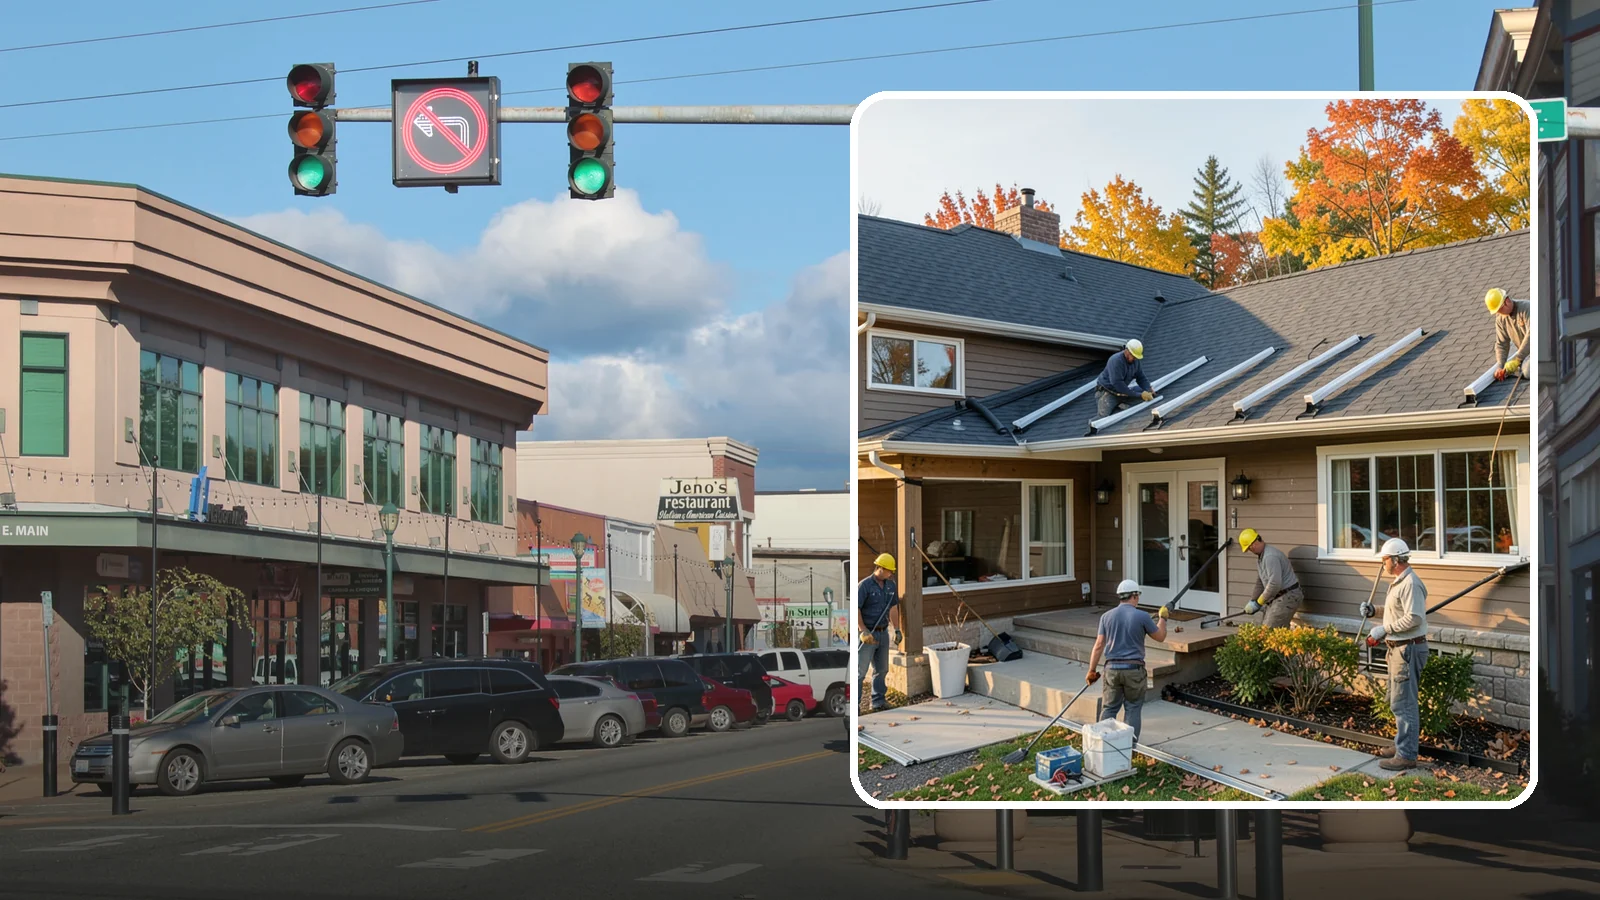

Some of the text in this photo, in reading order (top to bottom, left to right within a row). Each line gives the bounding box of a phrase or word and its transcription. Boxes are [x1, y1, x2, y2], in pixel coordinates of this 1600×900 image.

[670, 480, 728, 494] Jeno's
[664, 496, 731, 509] restaurant
[685, 509, 715, 519] American
[715, 509, 738, 519] Cuisine
[2, 525, 49, 536] E. MAIN
[797, 607, 829, 616] Street
